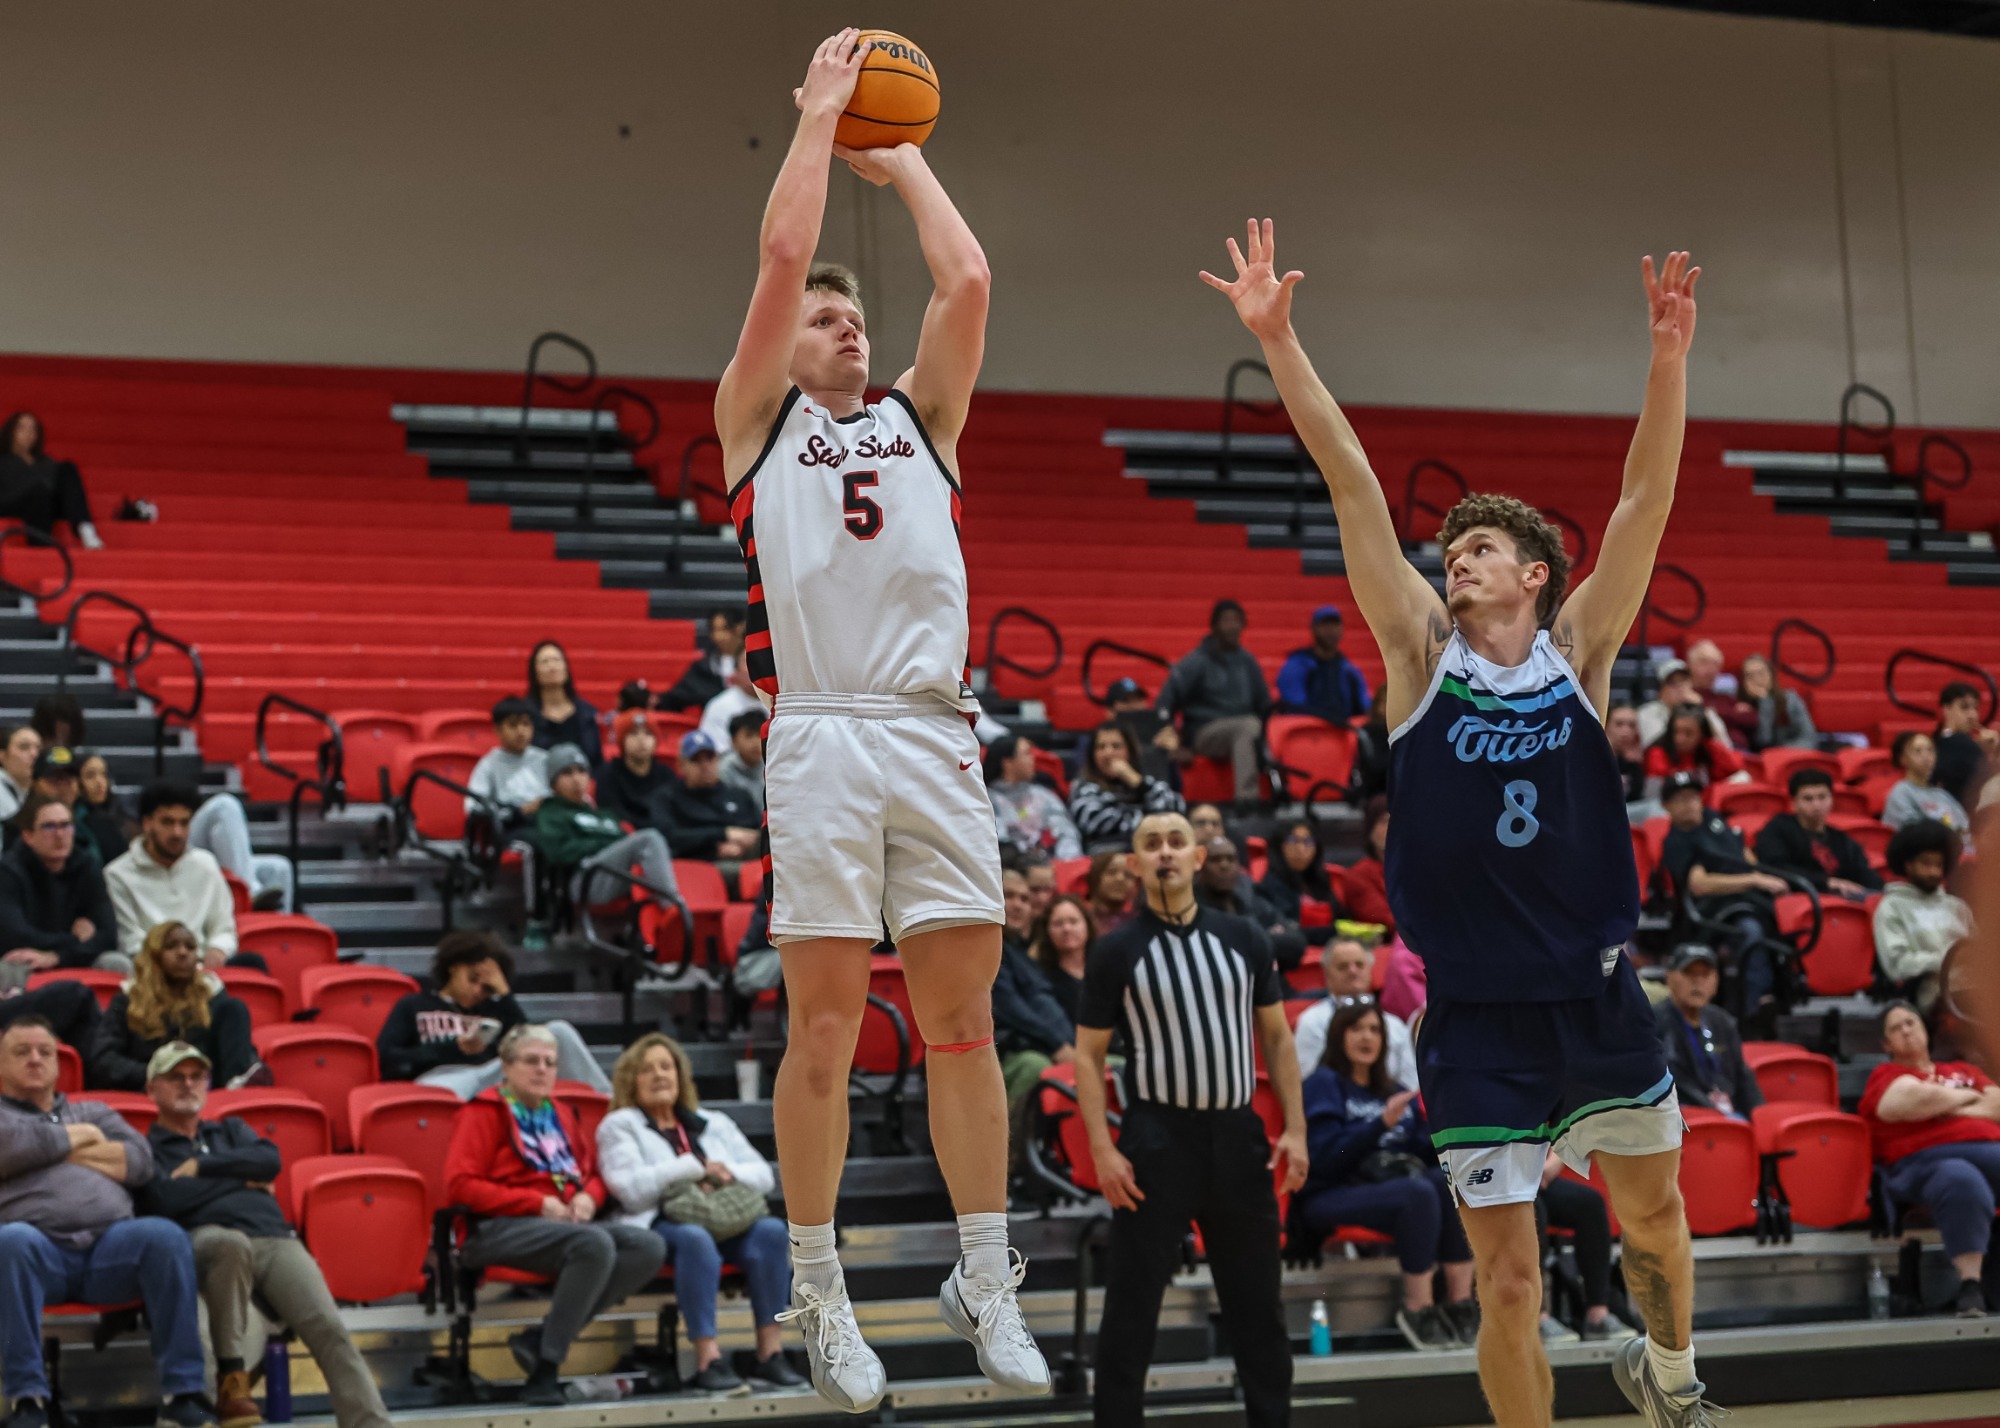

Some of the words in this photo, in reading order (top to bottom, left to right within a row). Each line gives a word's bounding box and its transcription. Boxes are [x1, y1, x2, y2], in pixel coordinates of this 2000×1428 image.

[855, 434, 915, 459] State
[842, 470, 884, 541] 5
[1447, 715, 1573, 763] Otters
[1496, 779, 1540, 848] 8
